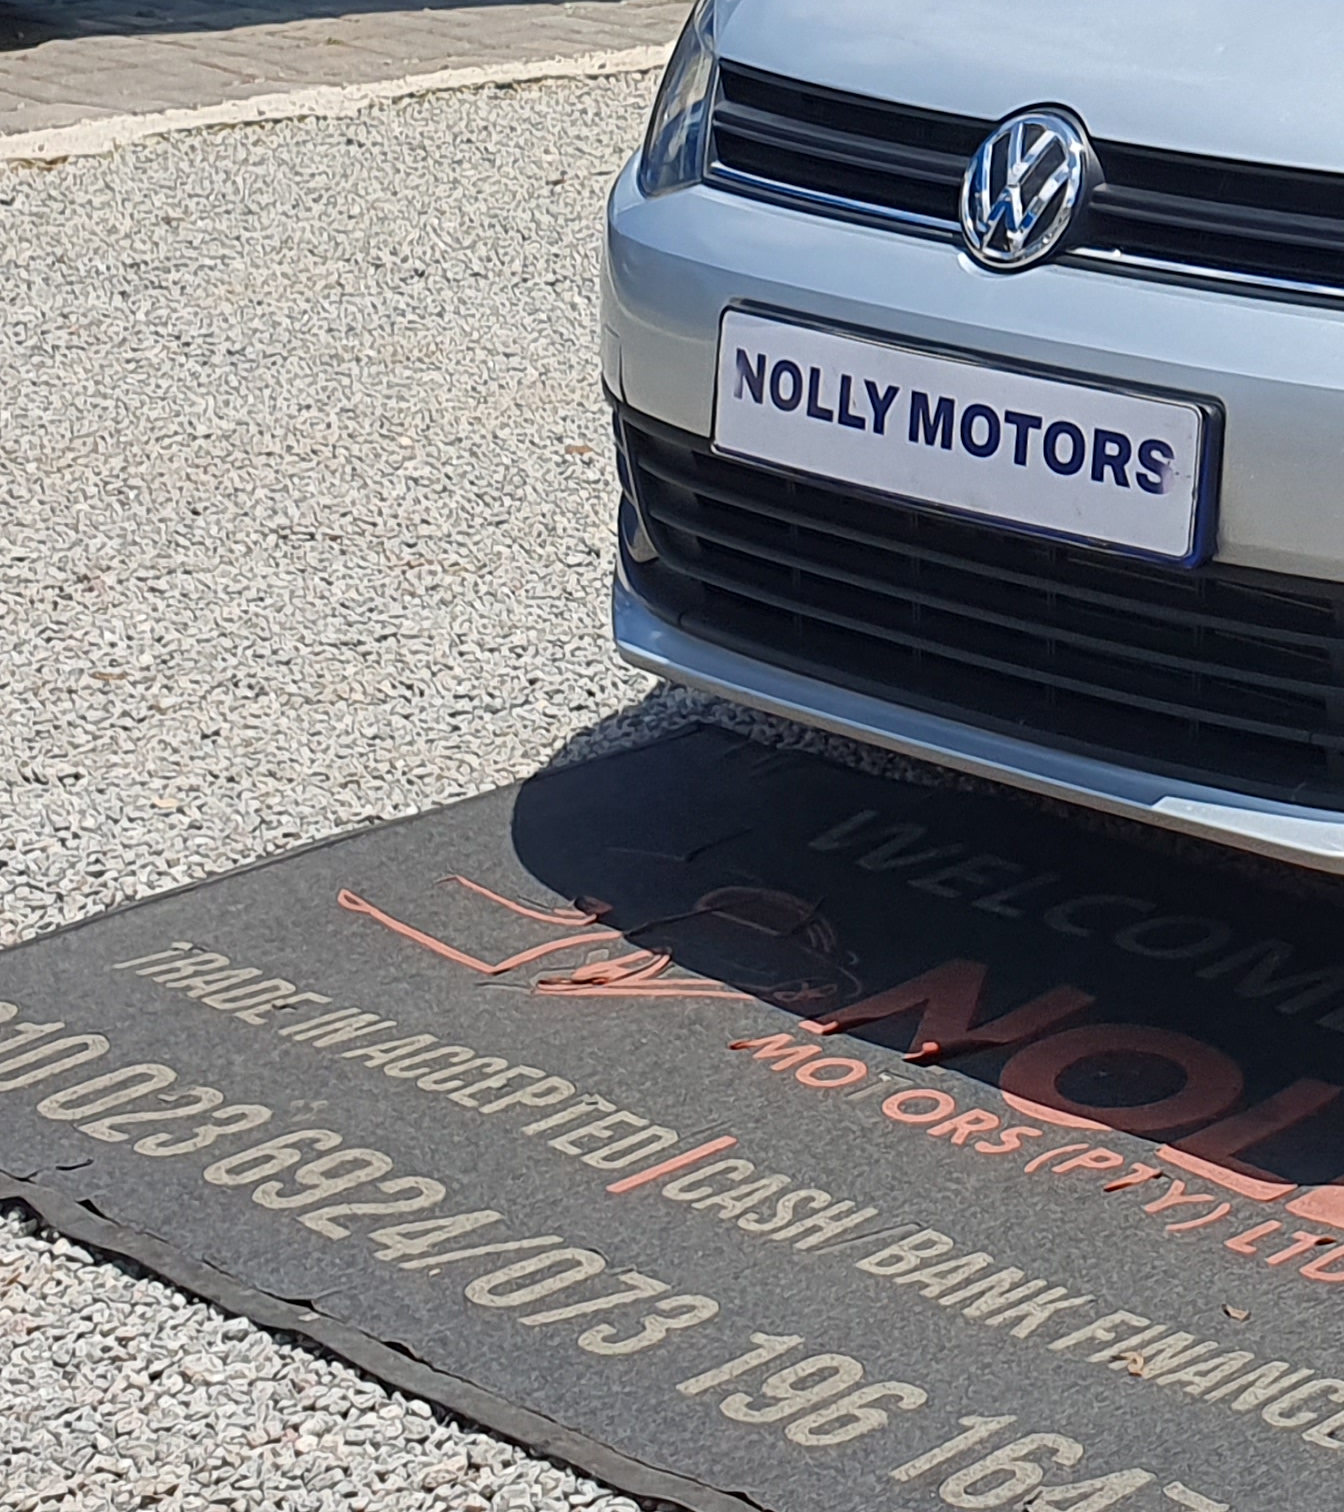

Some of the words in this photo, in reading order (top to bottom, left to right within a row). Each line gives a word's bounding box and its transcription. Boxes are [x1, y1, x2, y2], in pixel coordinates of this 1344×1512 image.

[733, 347, 900, 436] NOLLY
[908, 390, 1176, 496] MOTORS
[0, 1001, 110, 1088] 10
[111, 941, 334, 1025] TRADE
[278, 1007, 398, 1048] IN
[36, 1062, 273, 1157] 023
[728, 1033, 1044, 1154] MOTORS
[1024, 1143, 1232, 1232] (PTY)
[676, 1331, 928, 1447] 196
